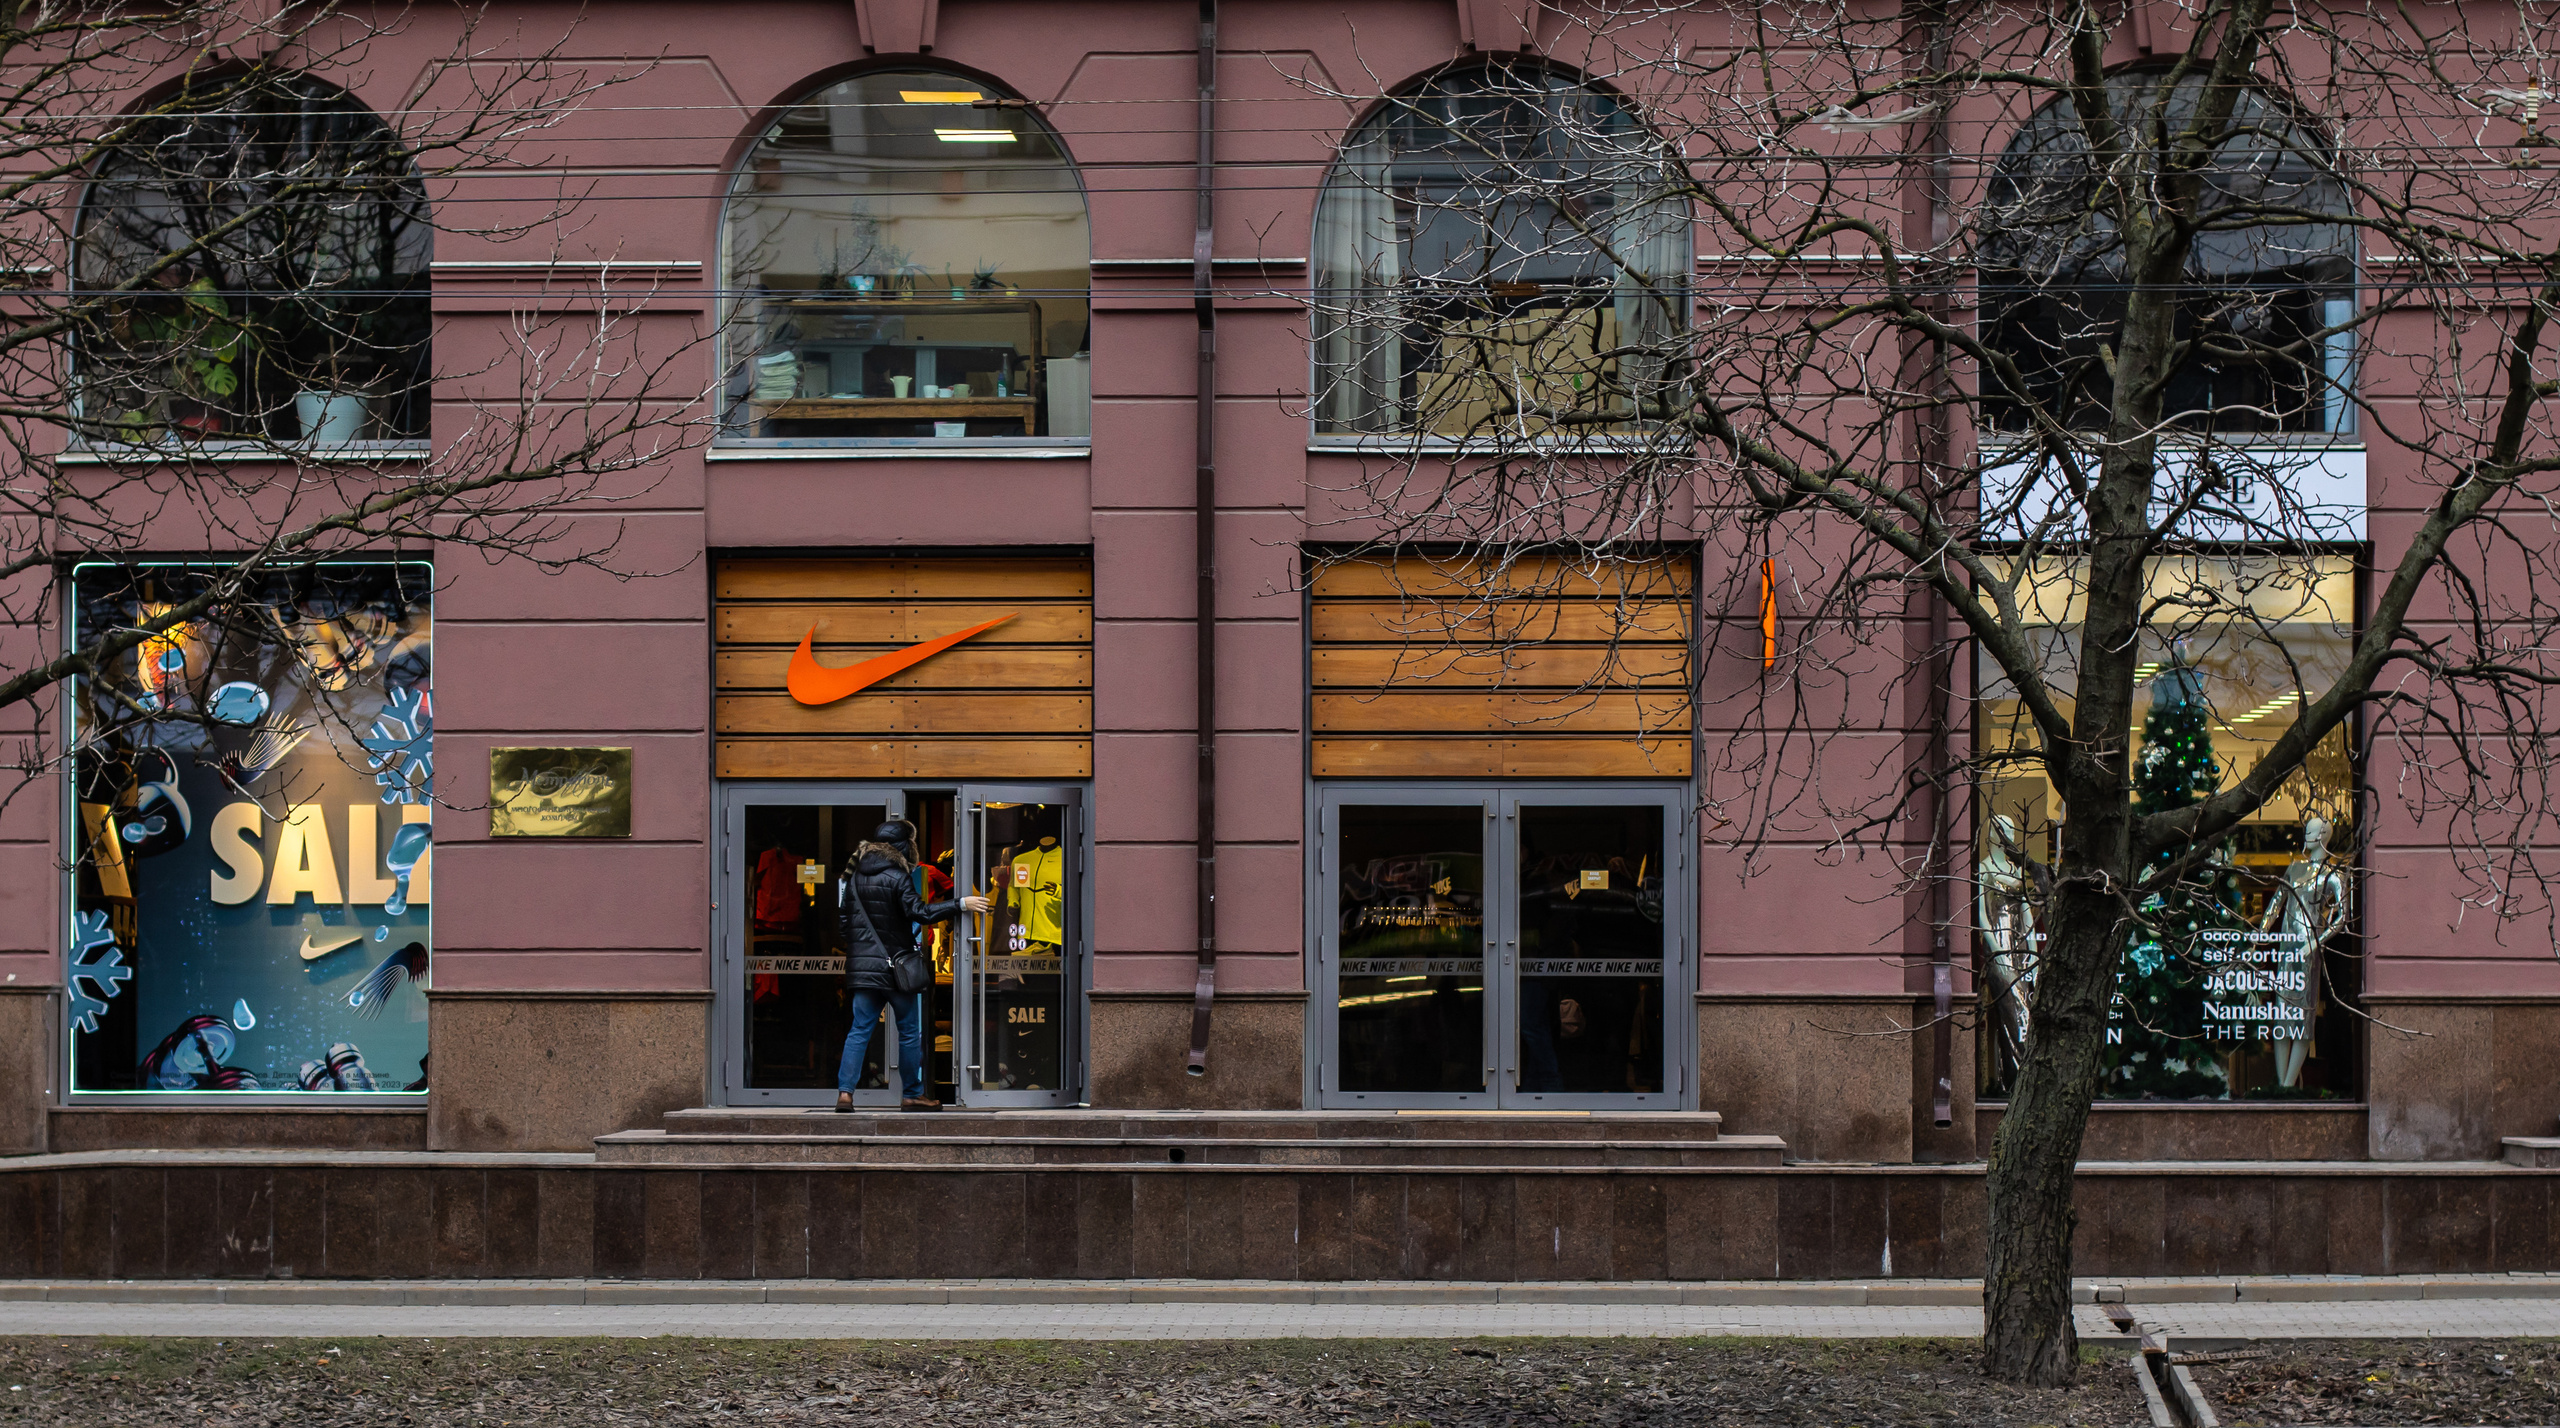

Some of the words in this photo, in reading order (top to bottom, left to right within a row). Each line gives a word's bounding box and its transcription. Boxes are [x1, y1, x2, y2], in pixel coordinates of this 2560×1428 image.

[745, 959, 772, 971] NIKE
[774, 959, 800, 971] NIKE
[803, 959, 829, 971] NIKE
[832, 959, 846, 971] NI
[992, 959, 1009, 970] NIKE
[1011, 959, 1028, 970] NIKE
[1029, 959, 1047, 971] NIKE
[1048, 959, 1061, 971] NIK
[1340, 961, 1367, 972] NIKE
[1369, 961, 1396, 972] NIKE
[1398, 961, 1425, 972] NIKE
[1427, 961, 1454, 972] NIKE
[1456, 961, 1483, 972] NIKE
[1520, 961, 1544, 973] NIKE
[1546, 961, 1573, 973] NIKE
[1576, 961, 1603, 973] NIKE
[1605, 961, 1632, 973] NIKE
[1634, 961, 1661, 973] NIKE
[2202, 970, 2306, 991] JACQUEMUS
[1008, 1006, 1046, 1023] SALE
[2202, 1001, 2305, 1020] Nanushka
[2202, 1024, 2245, 1040] THE
[2257, 1024, 2305, 1040] ROW
